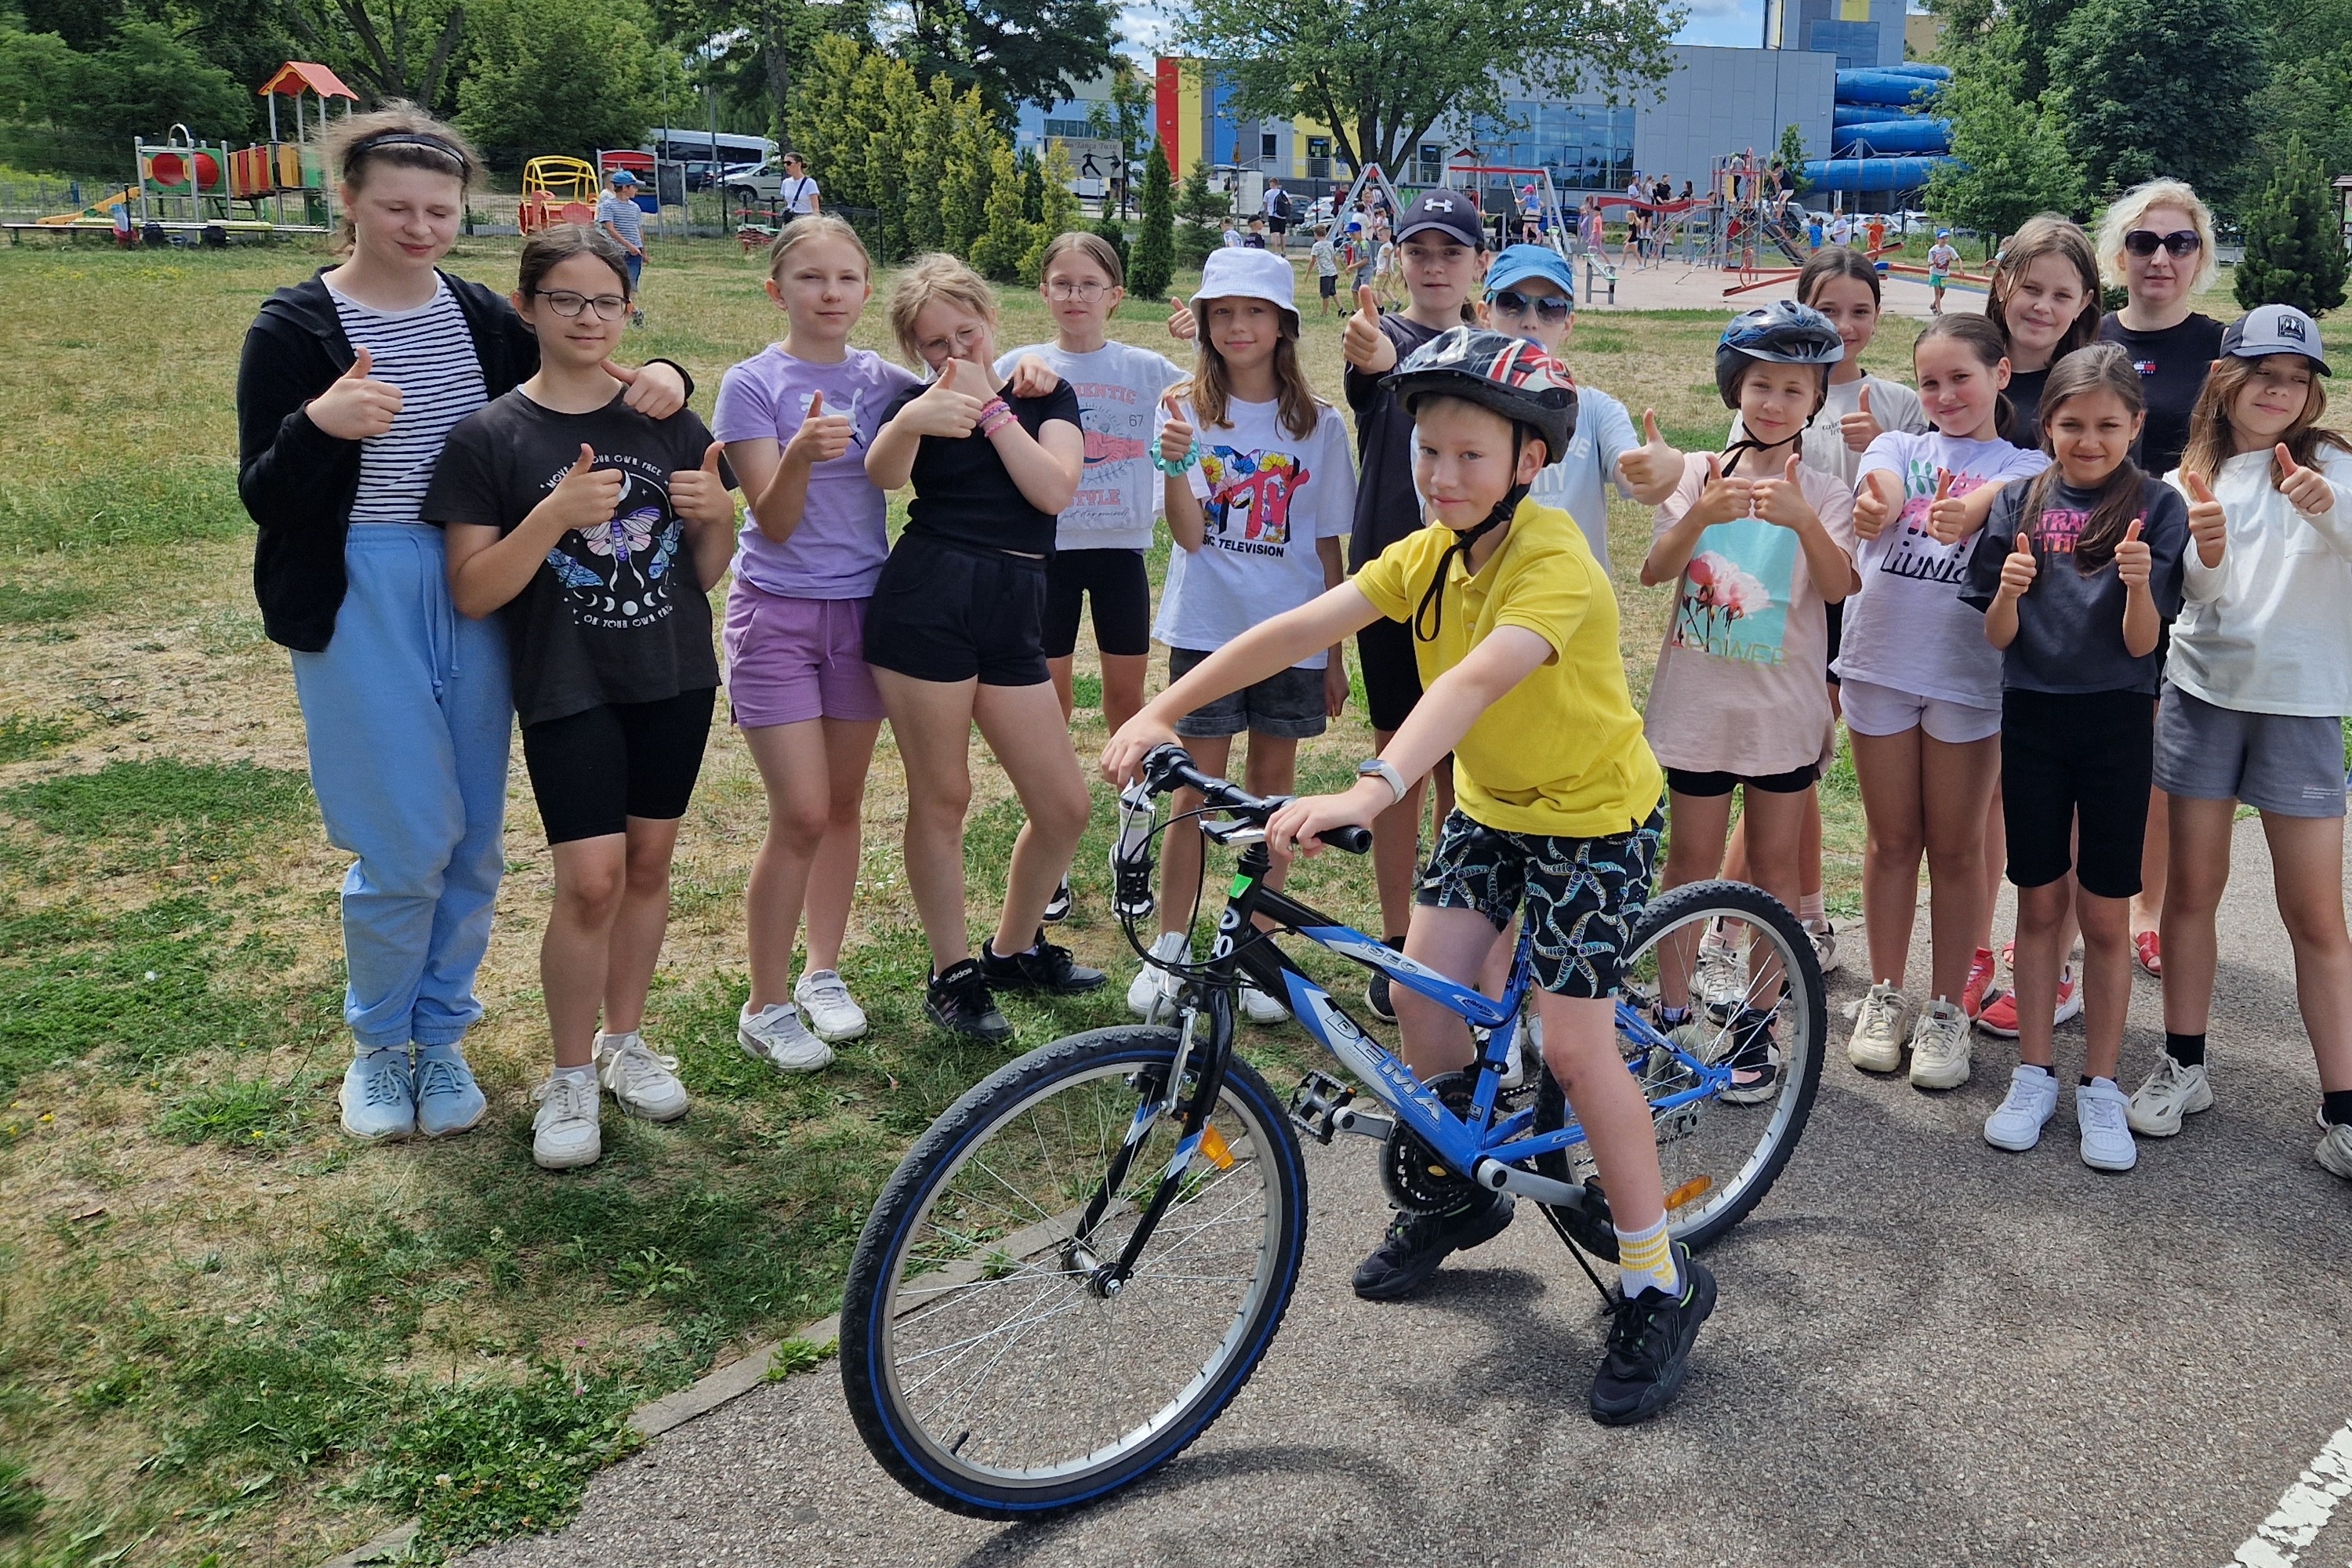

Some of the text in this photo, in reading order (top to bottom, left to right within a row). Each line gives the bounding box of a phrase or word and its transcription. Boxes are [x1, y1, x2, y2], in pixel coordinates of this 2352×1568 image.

[1073, 383, 1137, 405] HENTIC
[1128, 415, 1144, 427] 67
[593, 455, 610, 464] OUR
[614, 455, 638, 465] OWN
[1072, 489, 1121, 506] TYLE
[1203, 533, 1285, 557] SIC TELEVISION
[1358, 940, 1419, 974] ISEO
[946, 967, 973, 984] adidas
[1325, 1009, 1443, 1123] DEMA
